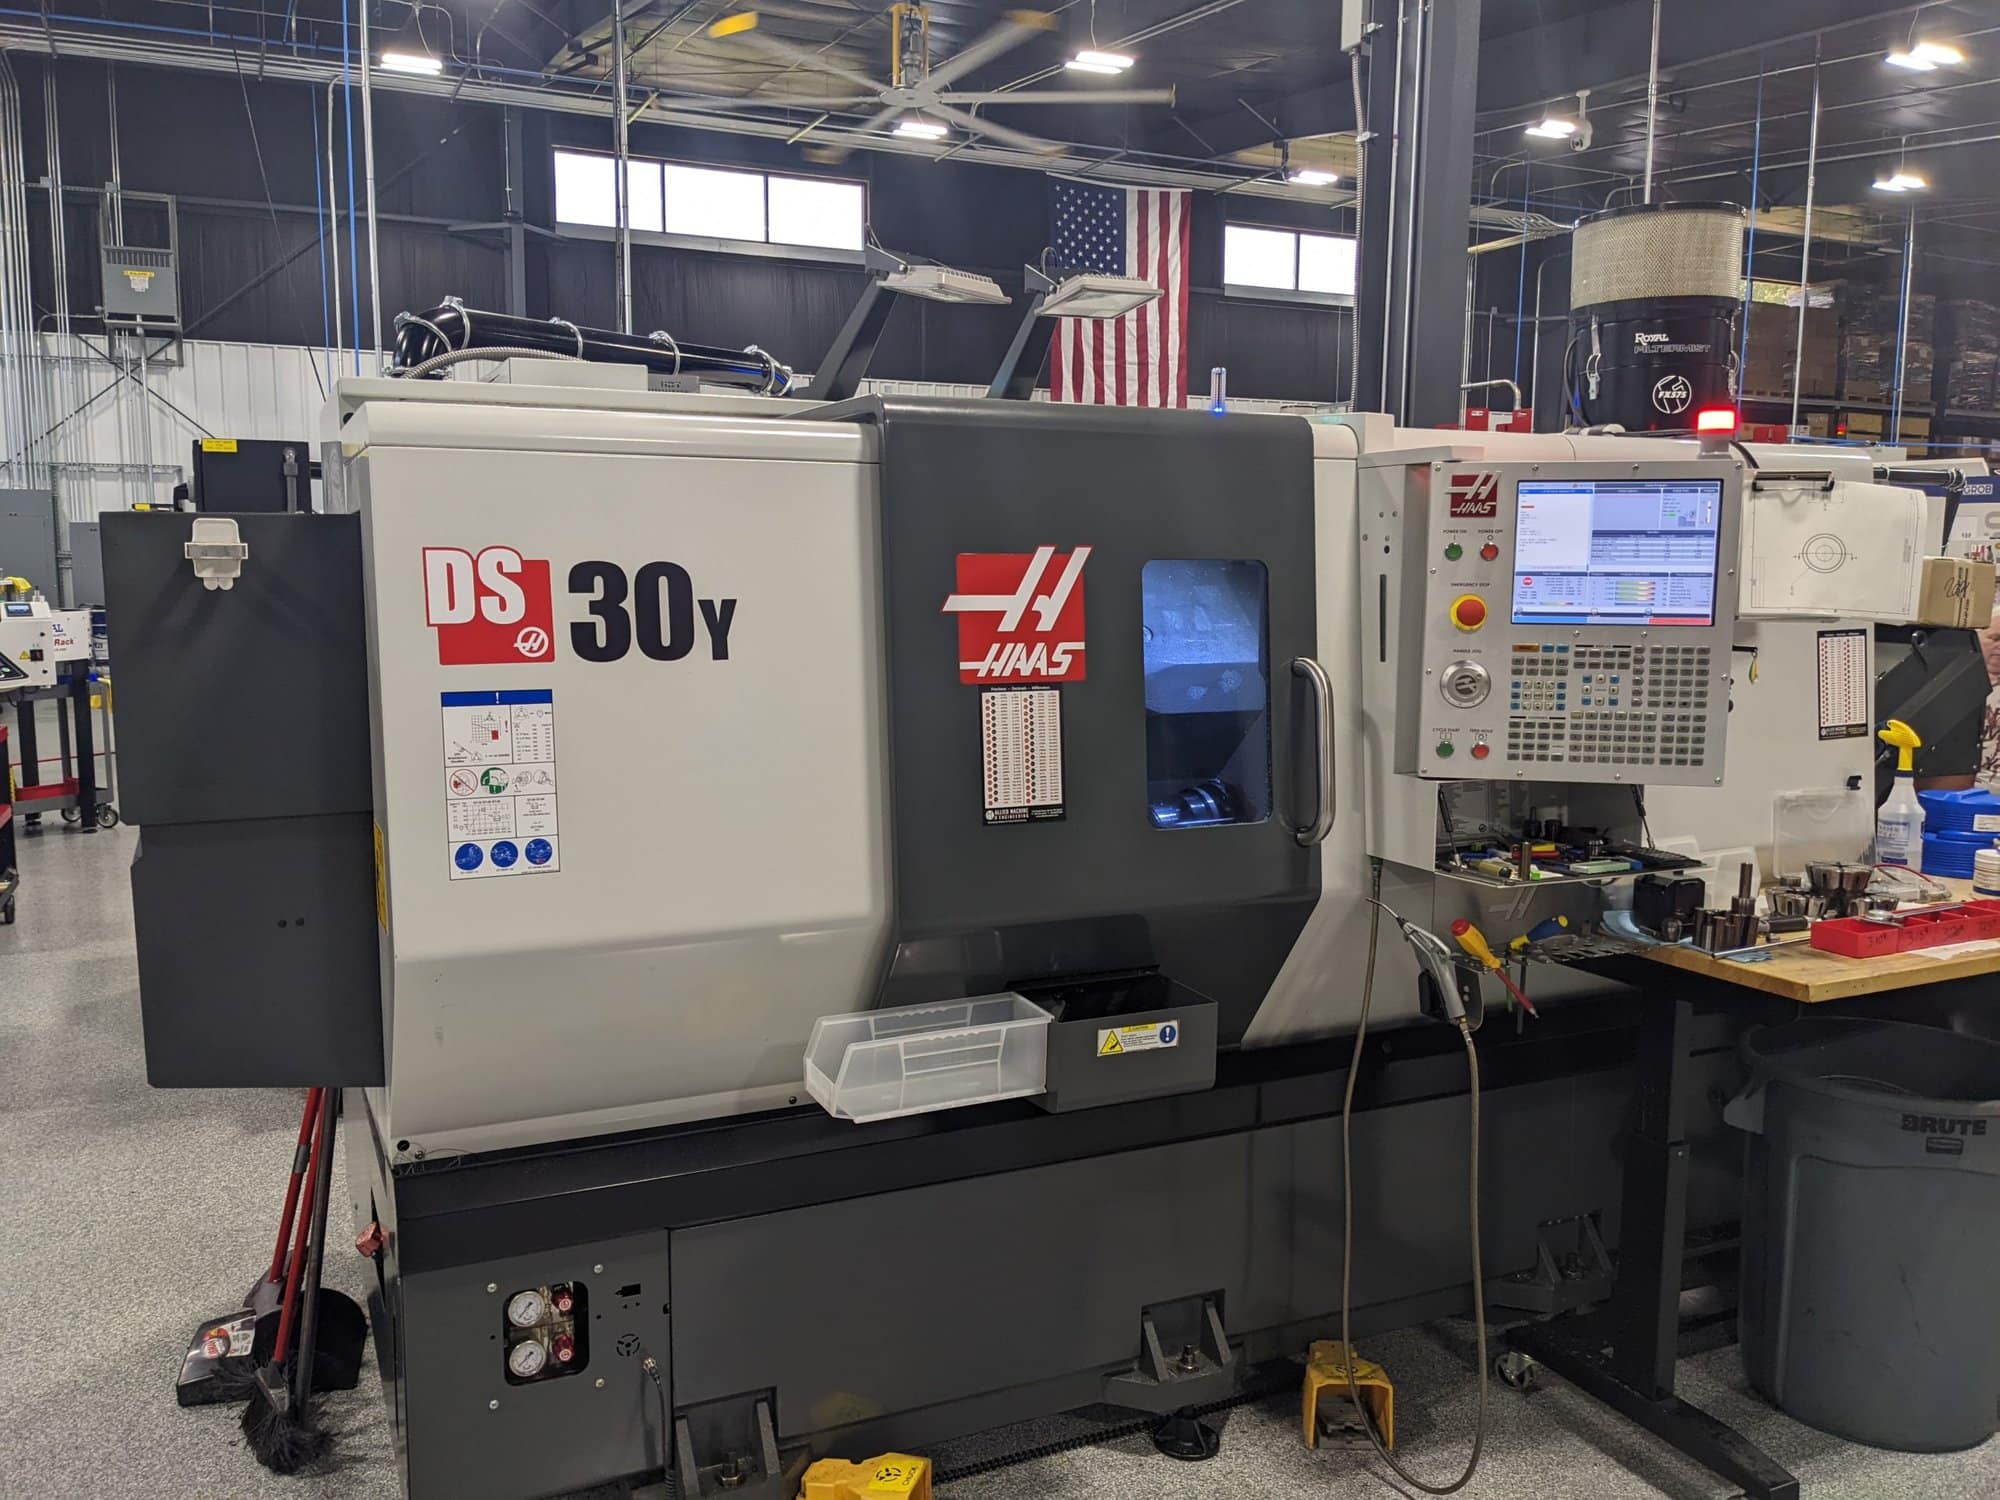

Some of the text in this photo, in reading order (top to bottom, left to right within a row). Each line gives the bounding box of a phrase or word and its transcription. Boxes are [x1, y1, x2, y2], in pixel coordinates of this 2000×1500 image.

[1963, 484, 1993, 495] GROB
[1450, 502, 1497, 514] HAAS
[423, 546, 526, 626] DS
[54, 638, 74, 646] Rack
[960, 641, 1085, 678] HAAS
[1902, 1113, 1986, 1136] BRUTE
